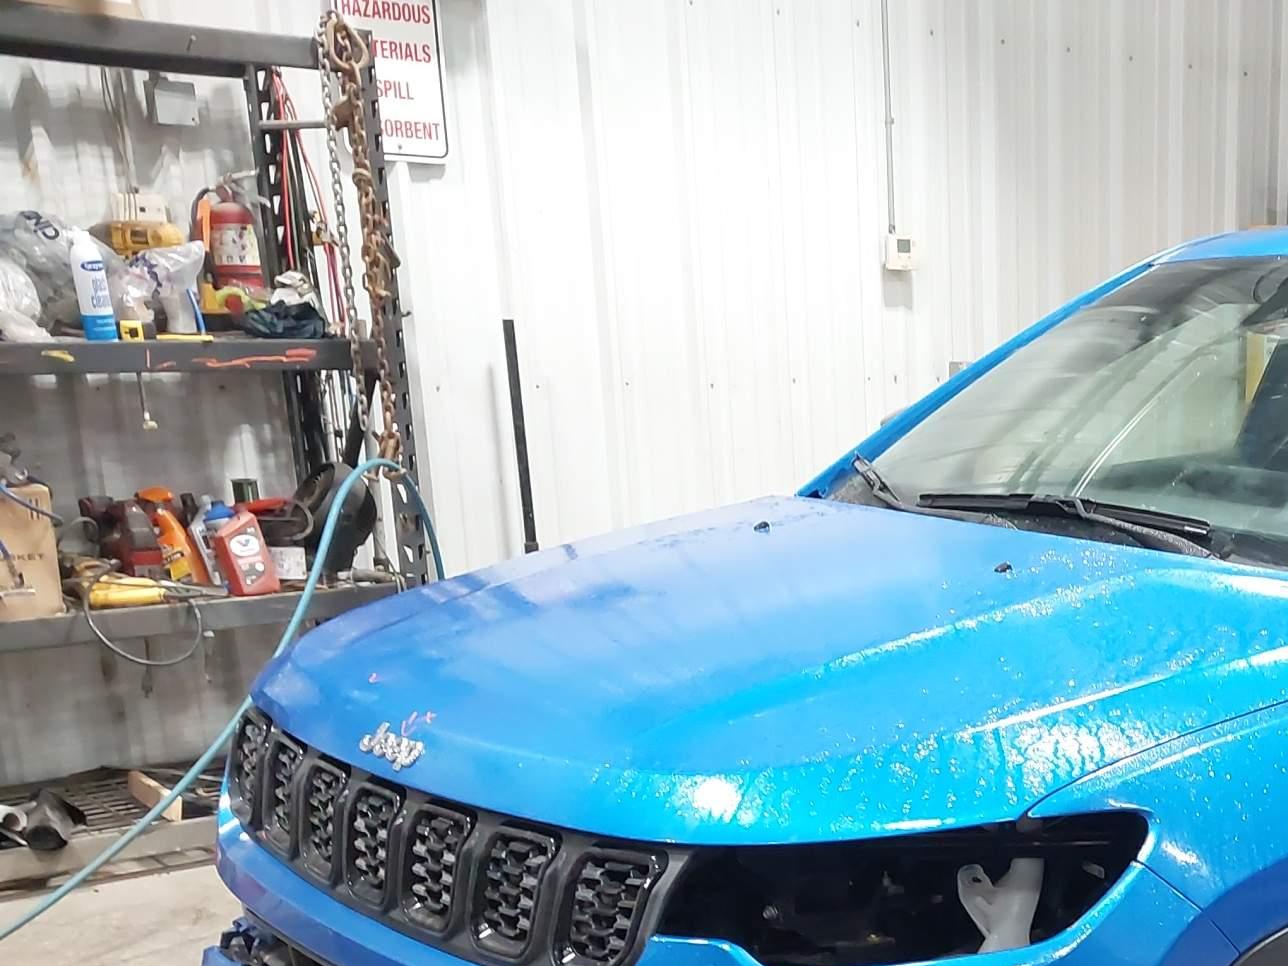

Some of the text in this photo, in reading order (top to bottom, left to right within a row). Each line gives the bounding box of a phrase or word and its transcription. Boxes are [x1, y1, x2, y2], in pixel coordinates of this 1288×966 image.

[341, 0, 431, 24] HAZARDOUS
[371, 39, 431, 63] TERIALS
[359, 721, 424, 771] Jeep
